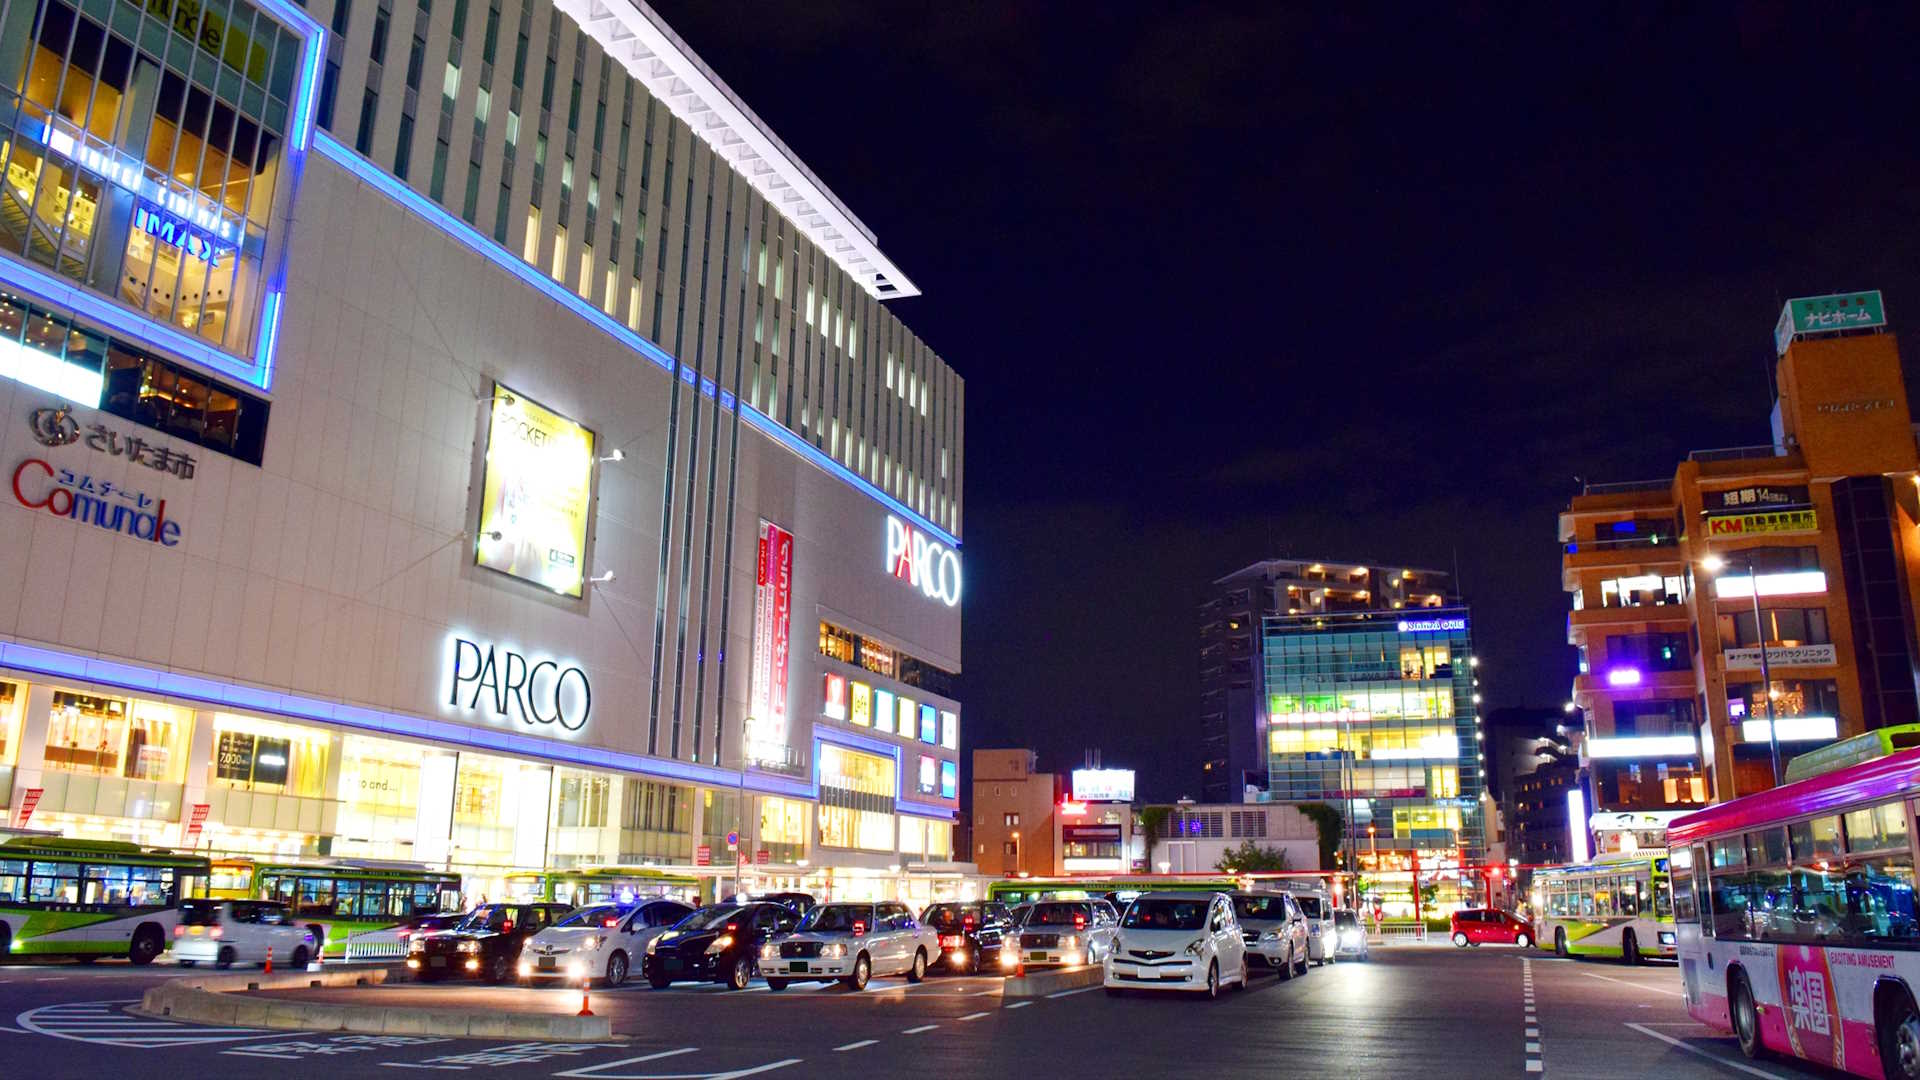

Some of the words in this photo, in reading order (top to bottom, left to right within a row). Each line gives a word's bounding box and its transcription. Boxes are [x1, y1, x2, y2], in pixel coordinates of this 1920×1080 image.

[134, 207, 218, 267] IMAX
[86, 423, 197, 480] さいたま市
[12, 458, 182, 547] Comunale
[1711, 518, 1743, 534] KM
[887, 514, 962, 607] PARCO
[448, 638, 592, 731] PARCO
[1830, 951, 1857, 966] EXCITING
[1858, 954, 1896, 969] AMUSEMENT
[1788, 965, 1831, 1036] 楽園
